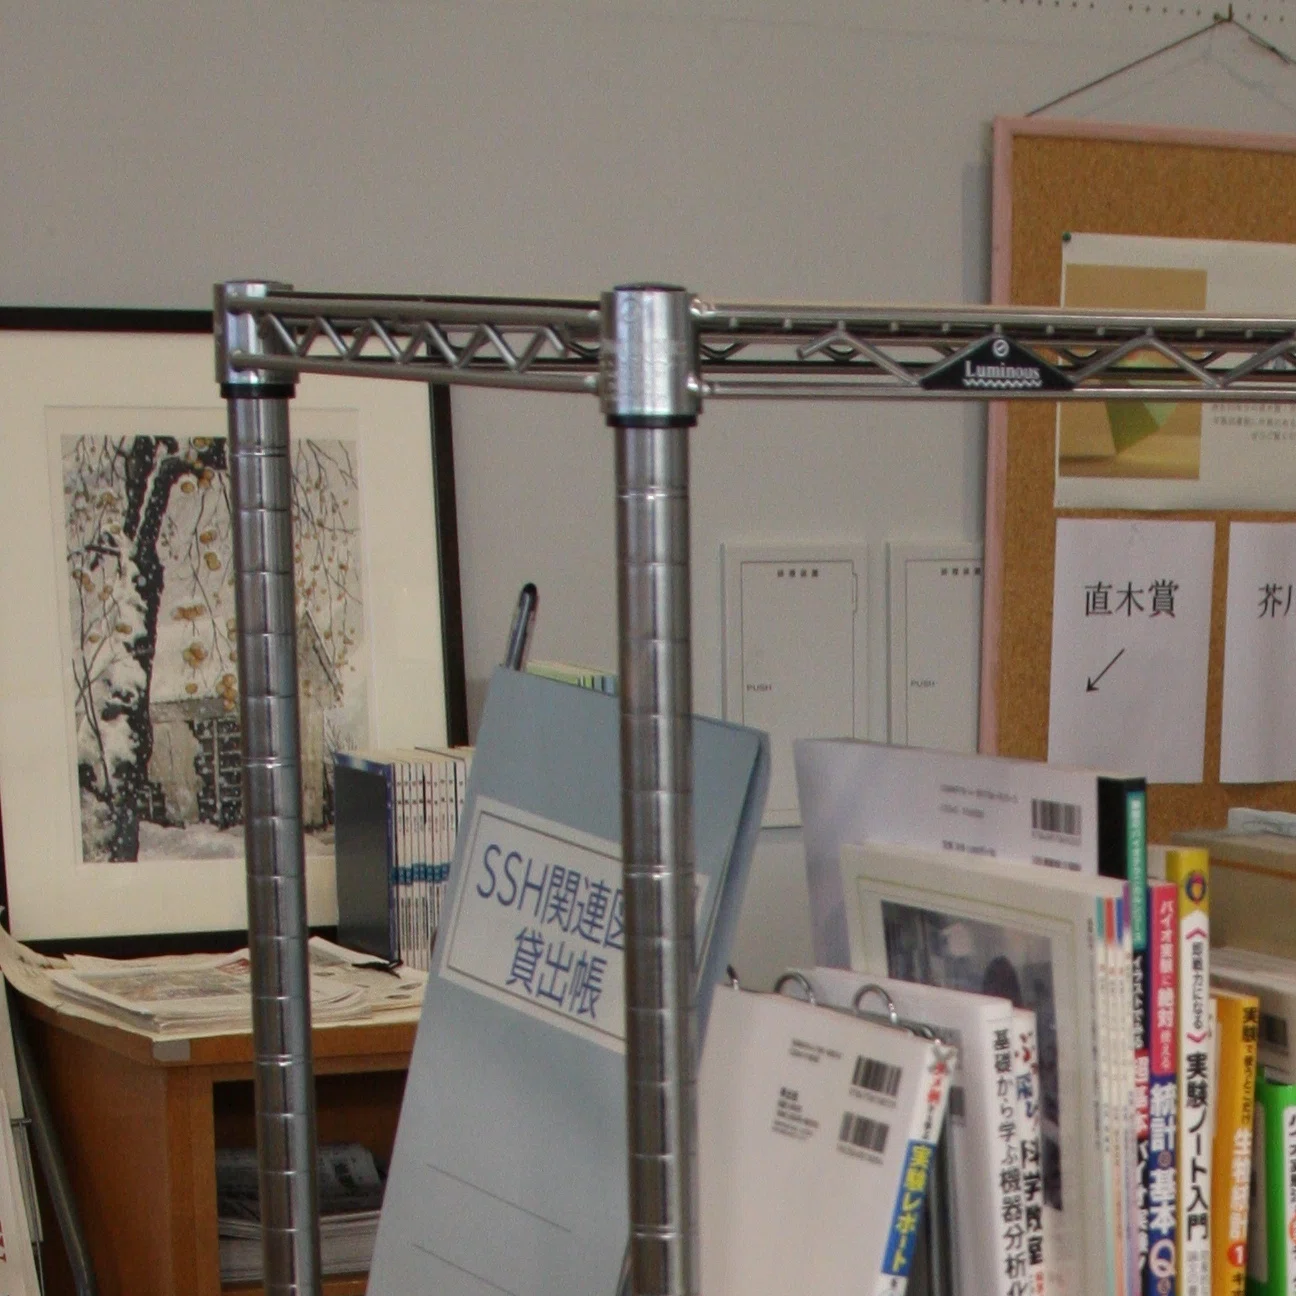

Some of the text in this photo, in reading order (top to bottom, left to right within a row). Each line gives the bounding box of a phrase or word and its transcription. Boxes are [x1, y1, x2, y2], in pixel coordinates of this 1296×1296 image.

[964, 360, 1041, 381] Luminous
[1084, 581, 1179, 619] 直木賞
[506, 927, 608, 1020] 貸出帳
[1186, 1053, 1210, 1241] 実験ノート入門
[892, 1145, 932, 1272] 実験レポート
